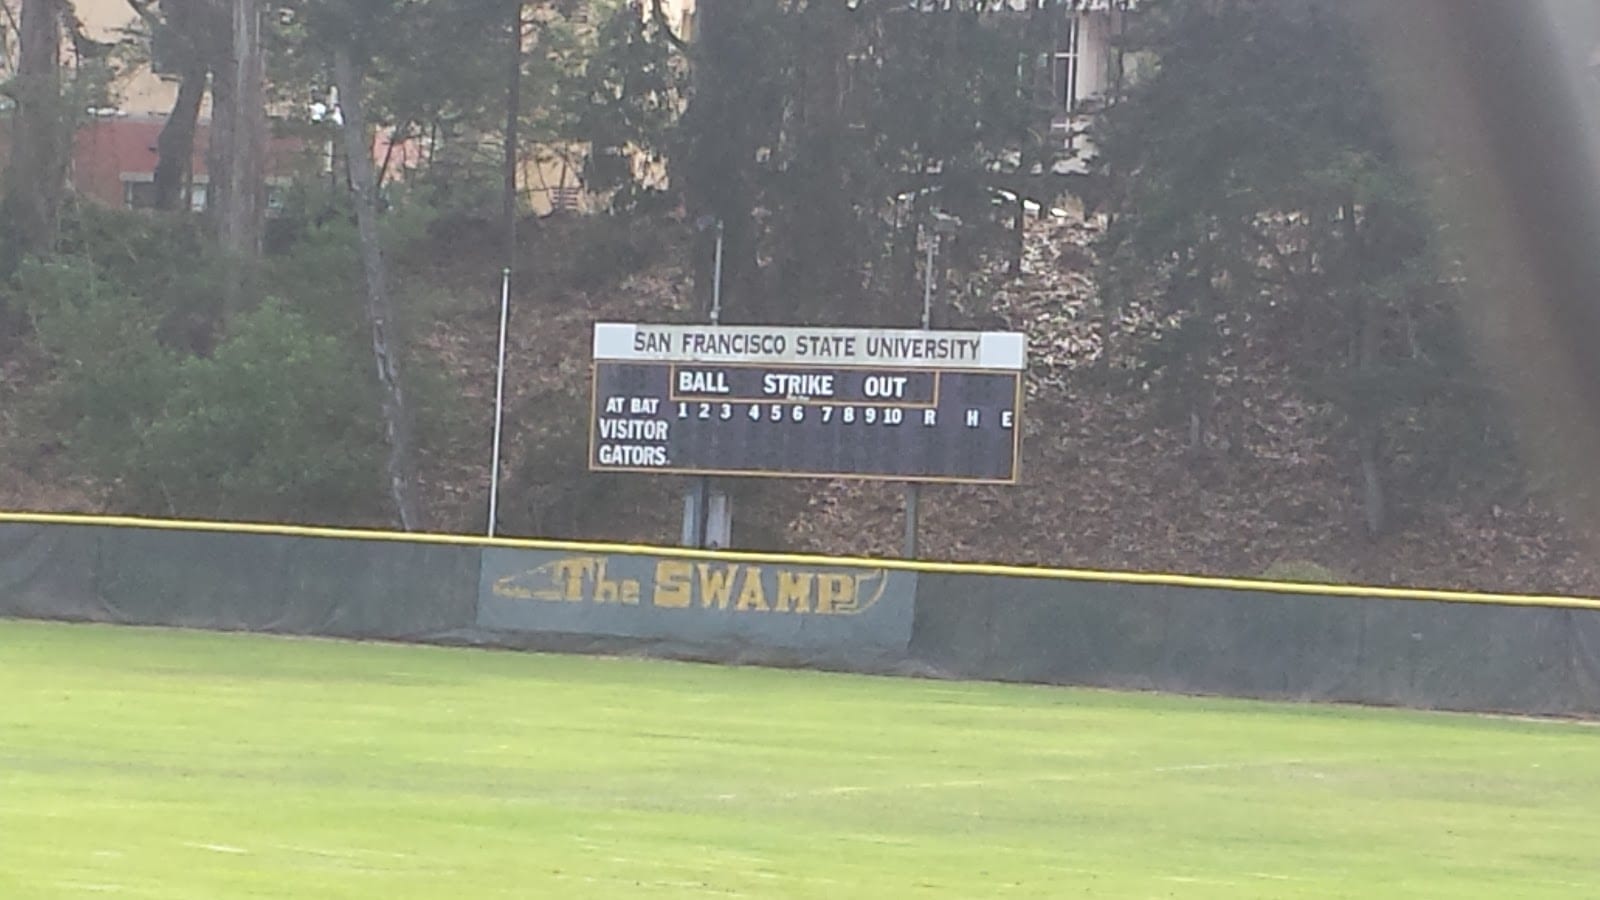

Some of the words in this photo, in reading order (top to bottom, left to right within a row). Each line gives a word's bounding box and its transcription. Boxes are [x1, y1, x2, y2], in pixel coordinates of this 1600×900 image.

[634, 332, 671, 352] SAN
[682, 333, 786, 354] FRANCISCO
[796, 336, 856, 356] STATE
[866, 336, 980, 360] UNIVERSITY
[679, 371, 729, 392] BALL
[763, 374, 834, 395] STRIKE
[864, 376, 907, 397] OUT
[606, 397, 624, 413] AT
[630, 398, 659, 414] BAT
[678, 402, 688, 418] 1
[699, 403, 710, 418] 2
[720, 404, 731, 419] 3
[748, 405, 760, 420] 4
[770, 405, 782, 421] 5
[792, 406, 804, 421] 6
[821, 407, 833, 422] 7
[843, 408, 854, 423] 8
[865, 408, 876, 423] 9
[883, 408, 902, 423] 10
[924, 410, 936, 425] R
[966, 410, 979, 427] H
[1001, 412, 1013, 427] E
[599, 418, 668, 440] VISITOR
[654, 559, 858, 614] SWAMP
